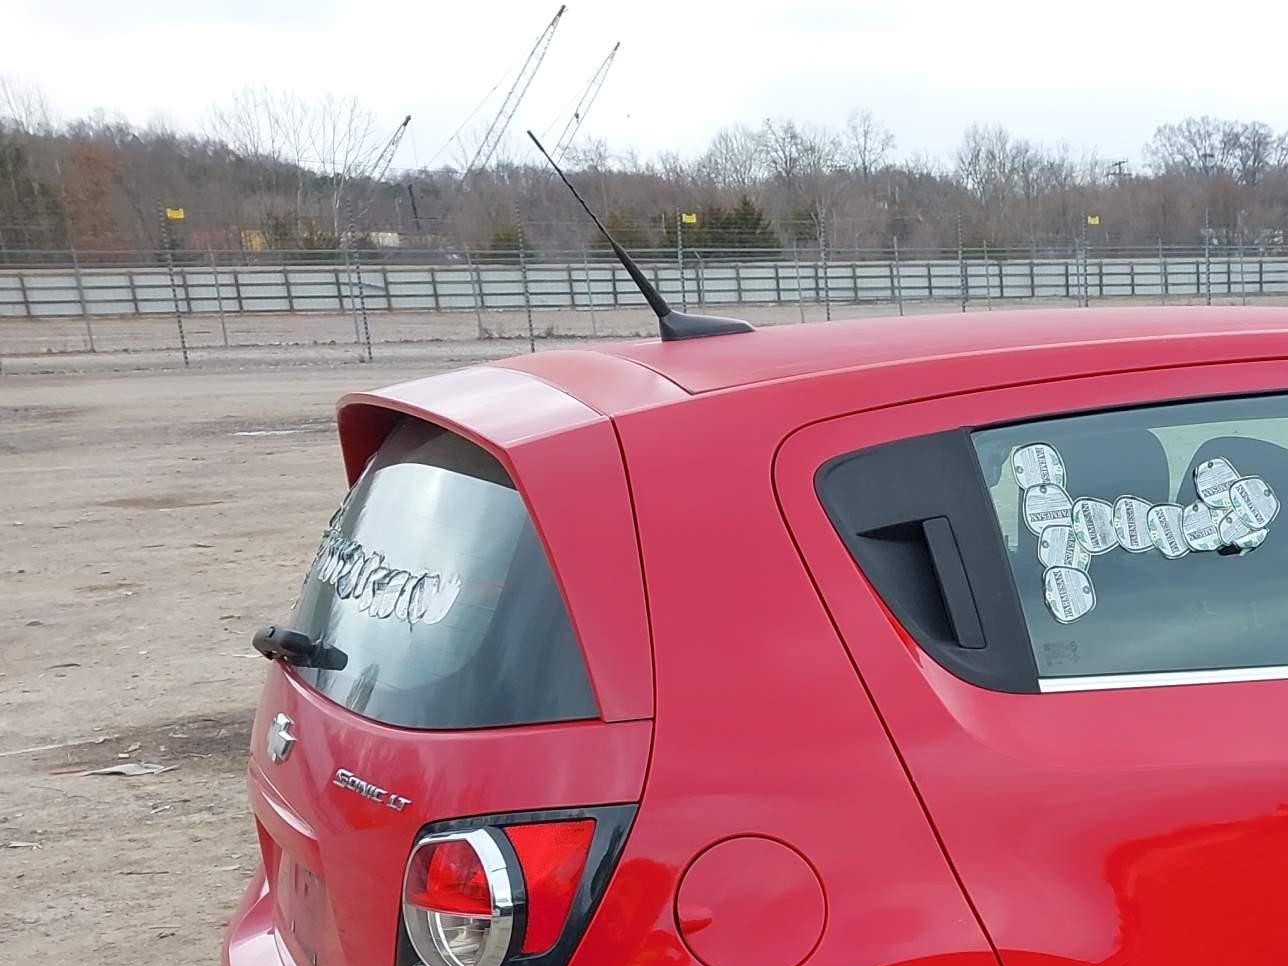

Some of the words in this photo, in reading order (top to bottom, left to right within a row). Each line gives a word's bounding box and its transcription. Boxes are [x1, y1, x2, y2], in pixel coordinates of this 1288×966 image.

[1124, 499, 1138, 546] PARMESAN
[1155, 507, 1179, 554] PARMESAN
[1053, 569, 1072, 618] PARMESAN
[333, 768, 387, 803] SONIC
[386, 794, 412, 812] LT
